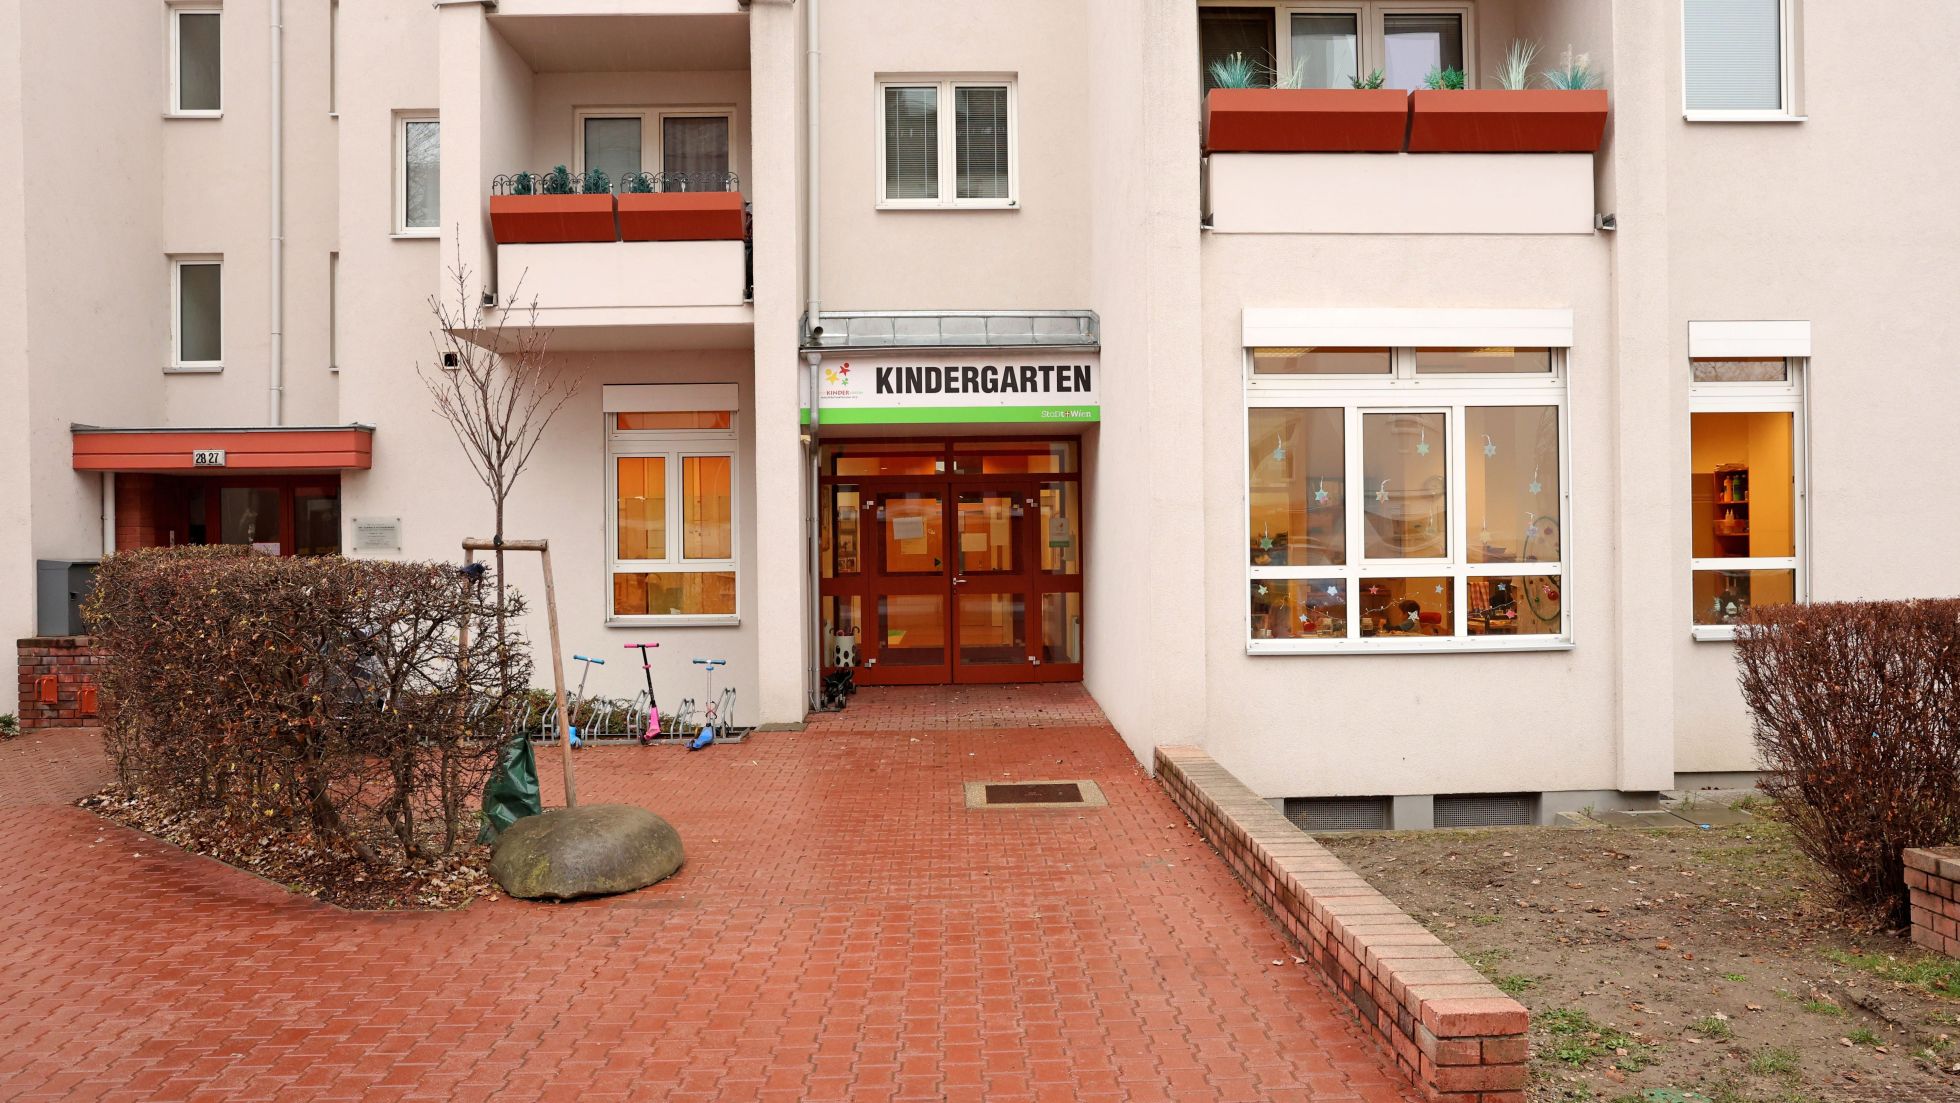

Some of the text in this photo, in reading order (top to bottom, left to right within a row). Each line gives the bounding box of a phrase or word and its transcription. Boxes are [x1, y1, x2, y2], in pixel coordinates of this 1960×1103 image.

[876, 366, 1091, 394] KINDERGARTEN
[1070, 410, 1091, 418] Wien
[195, 452, 219, 464] 28 27
